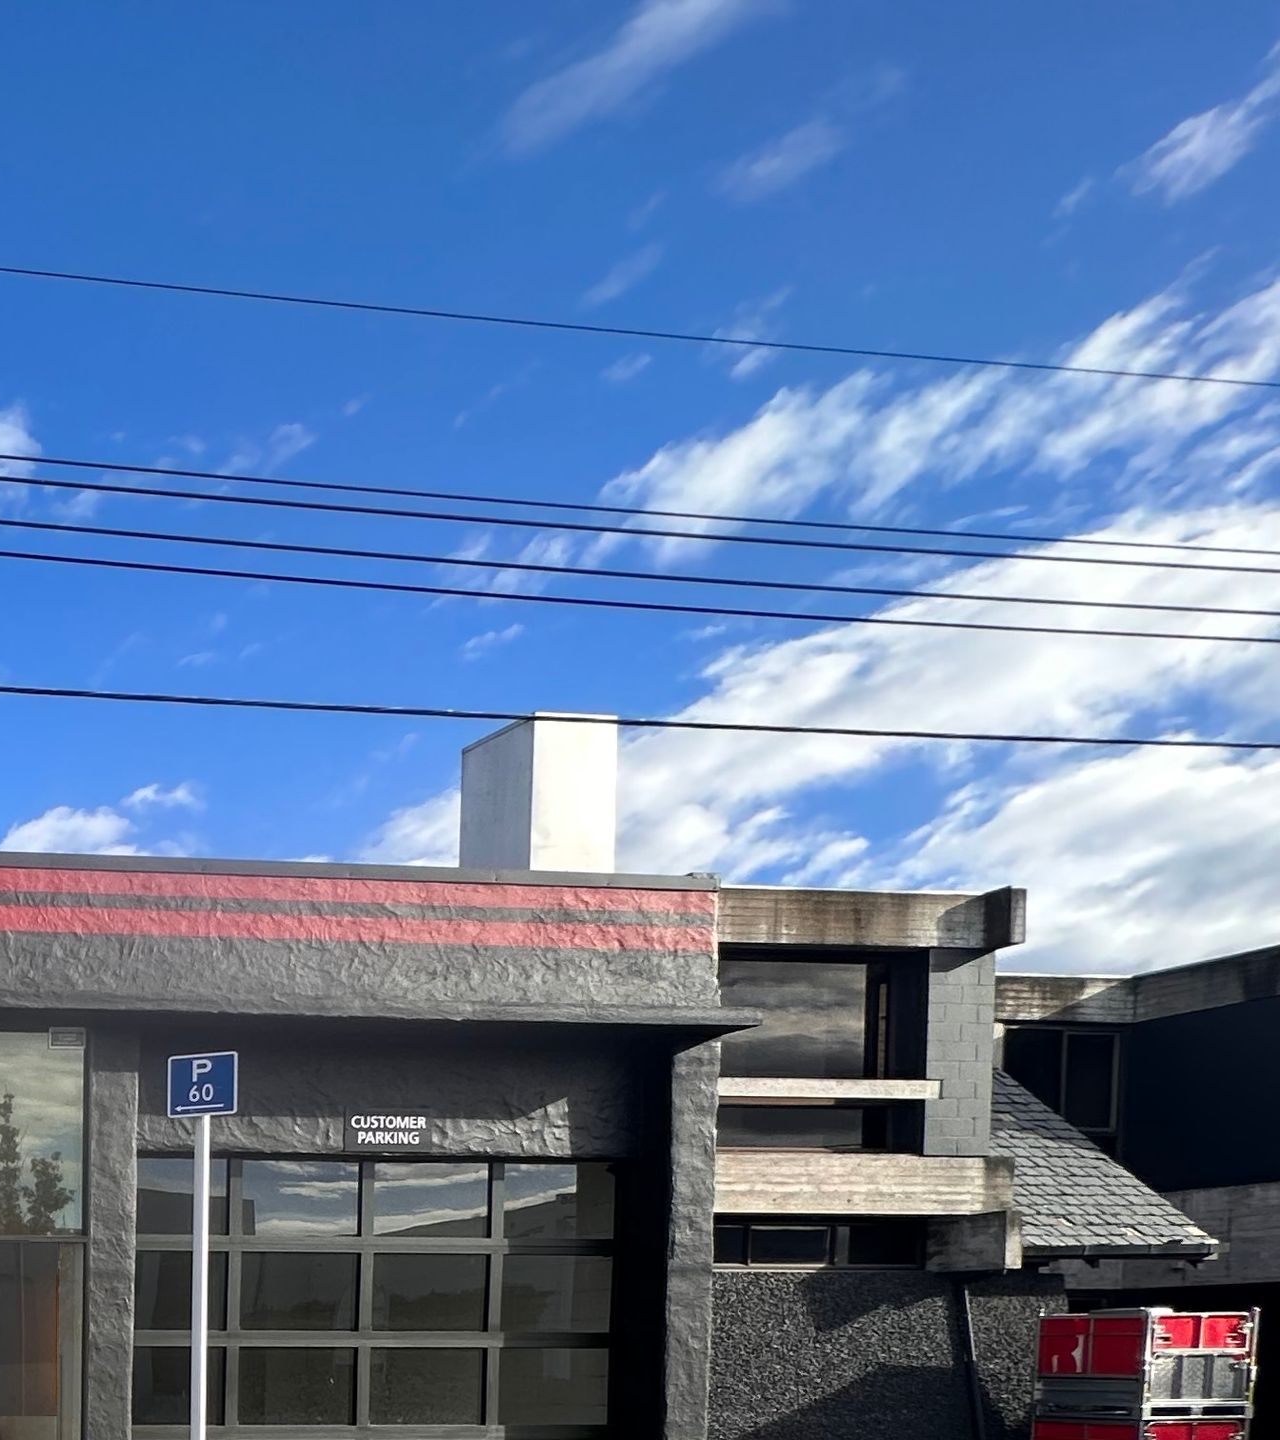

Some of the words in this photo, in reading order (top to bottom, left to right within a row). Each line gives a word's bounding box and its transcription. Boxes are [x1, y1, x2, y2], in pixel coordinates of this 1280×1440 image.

[192, 1059, 213, 1082] P
[189, 1083, 214, 1102] 60
[350, 1115, 426, 1129] CUSTOMER
[357, 1131, 420, 1145] PARKING
